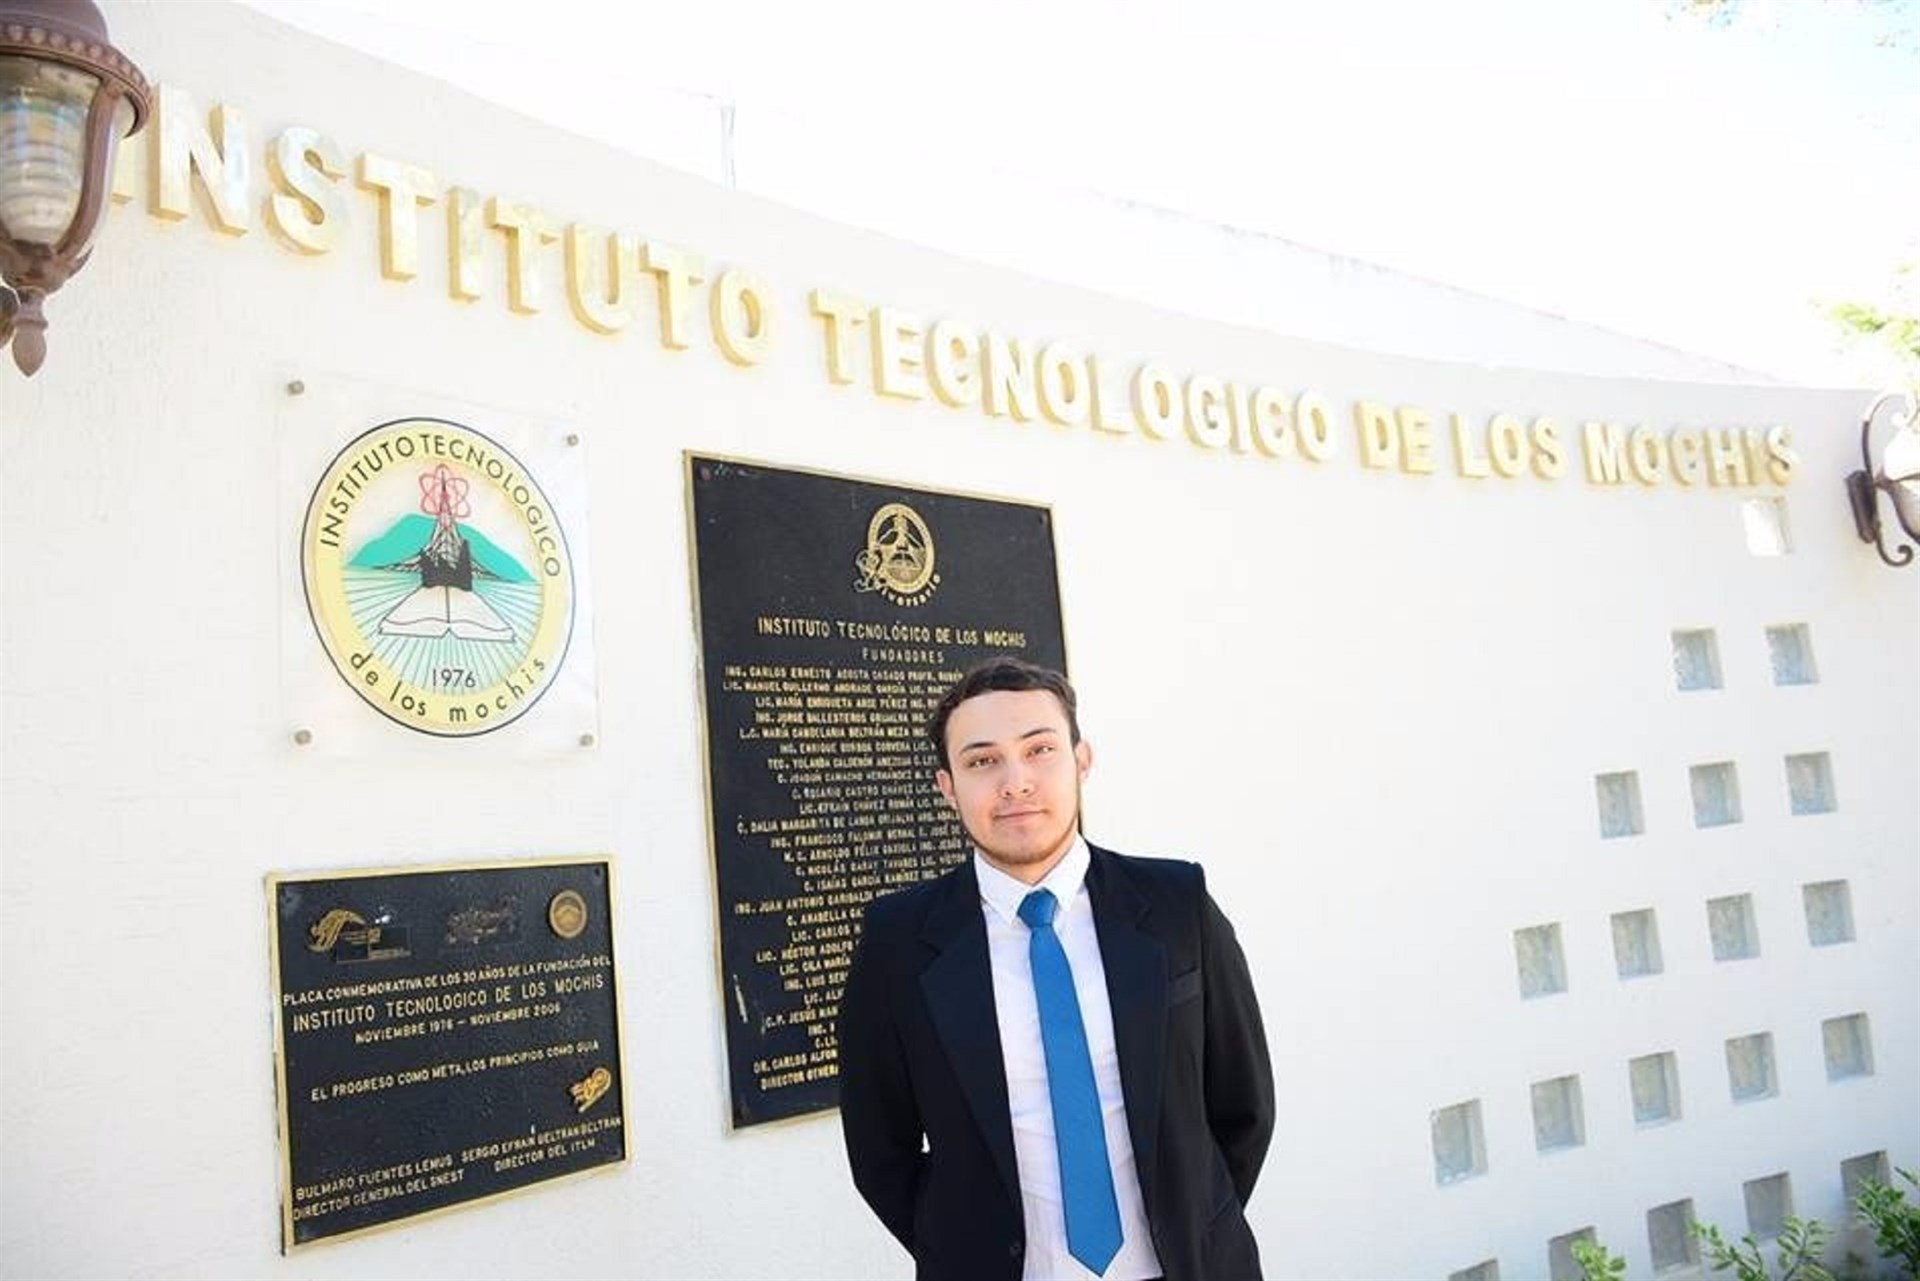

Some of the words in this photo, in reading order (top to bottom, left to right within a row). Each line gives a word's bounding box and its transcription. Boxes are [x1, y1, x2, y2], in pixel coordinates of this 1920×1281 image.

[807, 287, 1337, 463] TECNOLOGICO
[1354, 400, 1440, 475] DE
[1450, 410, 1570, 482] LOS
[1580, 420, 1803, 487] MOCHIS
[319, 435, 415, 548] INSTITUTO
[418, 433, 561, 578] TECNOLOGICO
[757, 616, 831, 639] INSTITUTO
[836, 619, 930, 644] TECNOLÓGICO
[934, 627, 956, 644] DE
[956, 628, 979, 647] LOS
[983, 631, 1027, 649] MOCHIS
[749, 666, 787, 678] CARLOS
[862, 646, 945, 664] FUNDADORES
[350, 651, 379, 687] de
[390, 681, 427, 717] los
[449, 656, 546, 723] mochis
[432, 668, 476, 689] 1976
[744, 681, 781, 692] MANUEL
[283, 990, 324, 1006] PLACA
[325, 978, 423, 1001] CONMEMORATIVA
[441, 972, 461, 986] LOS
[293, 1005, 376, 1033] INSTITUTO
[386, 989, 487, 1018] TECNOLOGICO
[495, 985, 512, 1004] DE
[521, 982, 547, 1000] LOS
[555, 973, 605, 994] MOCHIS
[355, 1022, 426, 1044] NOVIEMBRE
[469, 1006, 530, 1027] NOVIEMBRE
[311, 1087, 328, 1102] EL
[332, 1074, 394, 1098] PROGRESO
[397, 1069, 431, 1086] COMO
[489, 1049, 545, 1068] PRINCIPIOS
[547, 1044, 575, 1058] COMO
[461, 1144, 500, 1164] SERGIO
[494, 1149, 545, 1173] DIRECTOR
[547, 1145, 568, 1160] DEL
[295, 1175, 356, 1201] BULMARO
[358, 1163, 414, 1187] FUENTES
[415, 1153, 454, 1175] LEMUS
[293, 1196, 350, 1222] DIRECTOR
[352, 1184, 405, 1206] GENERAL
[406, 1178, 428, 1194] DEL
